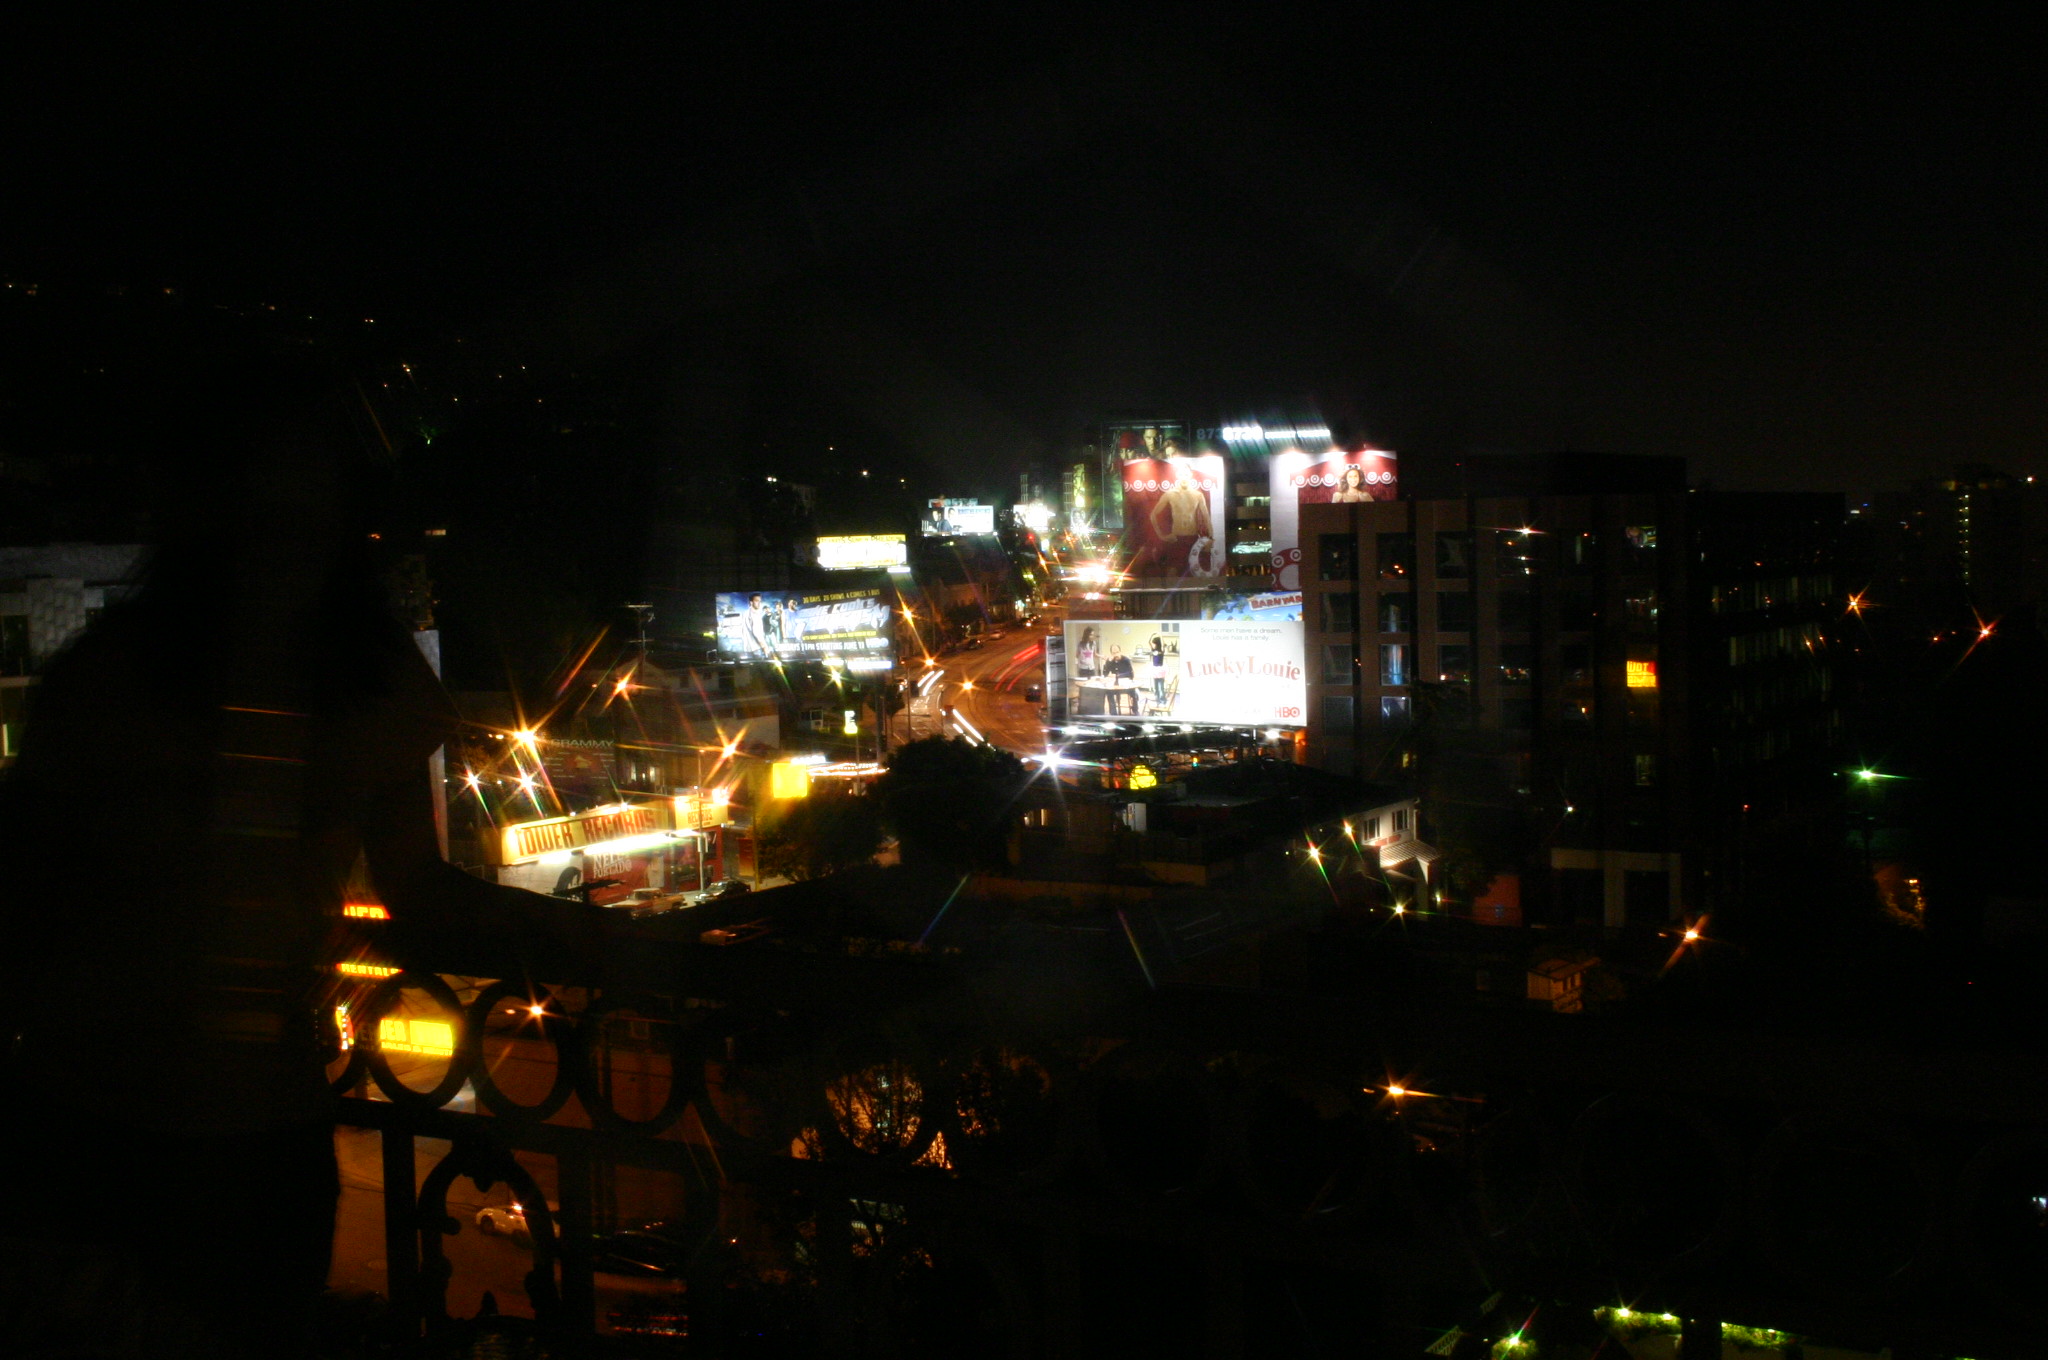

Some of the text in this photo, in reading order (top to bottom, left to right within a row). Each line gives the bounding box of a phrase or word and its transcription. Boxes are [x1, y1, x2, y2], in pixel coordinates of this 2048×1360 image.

[1186, 655, 1301, 681] Lucky Louie
[1274, 706, 1301, 718] HBO
[551, 739, 614, 747] GRAMMY
[514, 809, 657, 856] TOWER RECORDS
